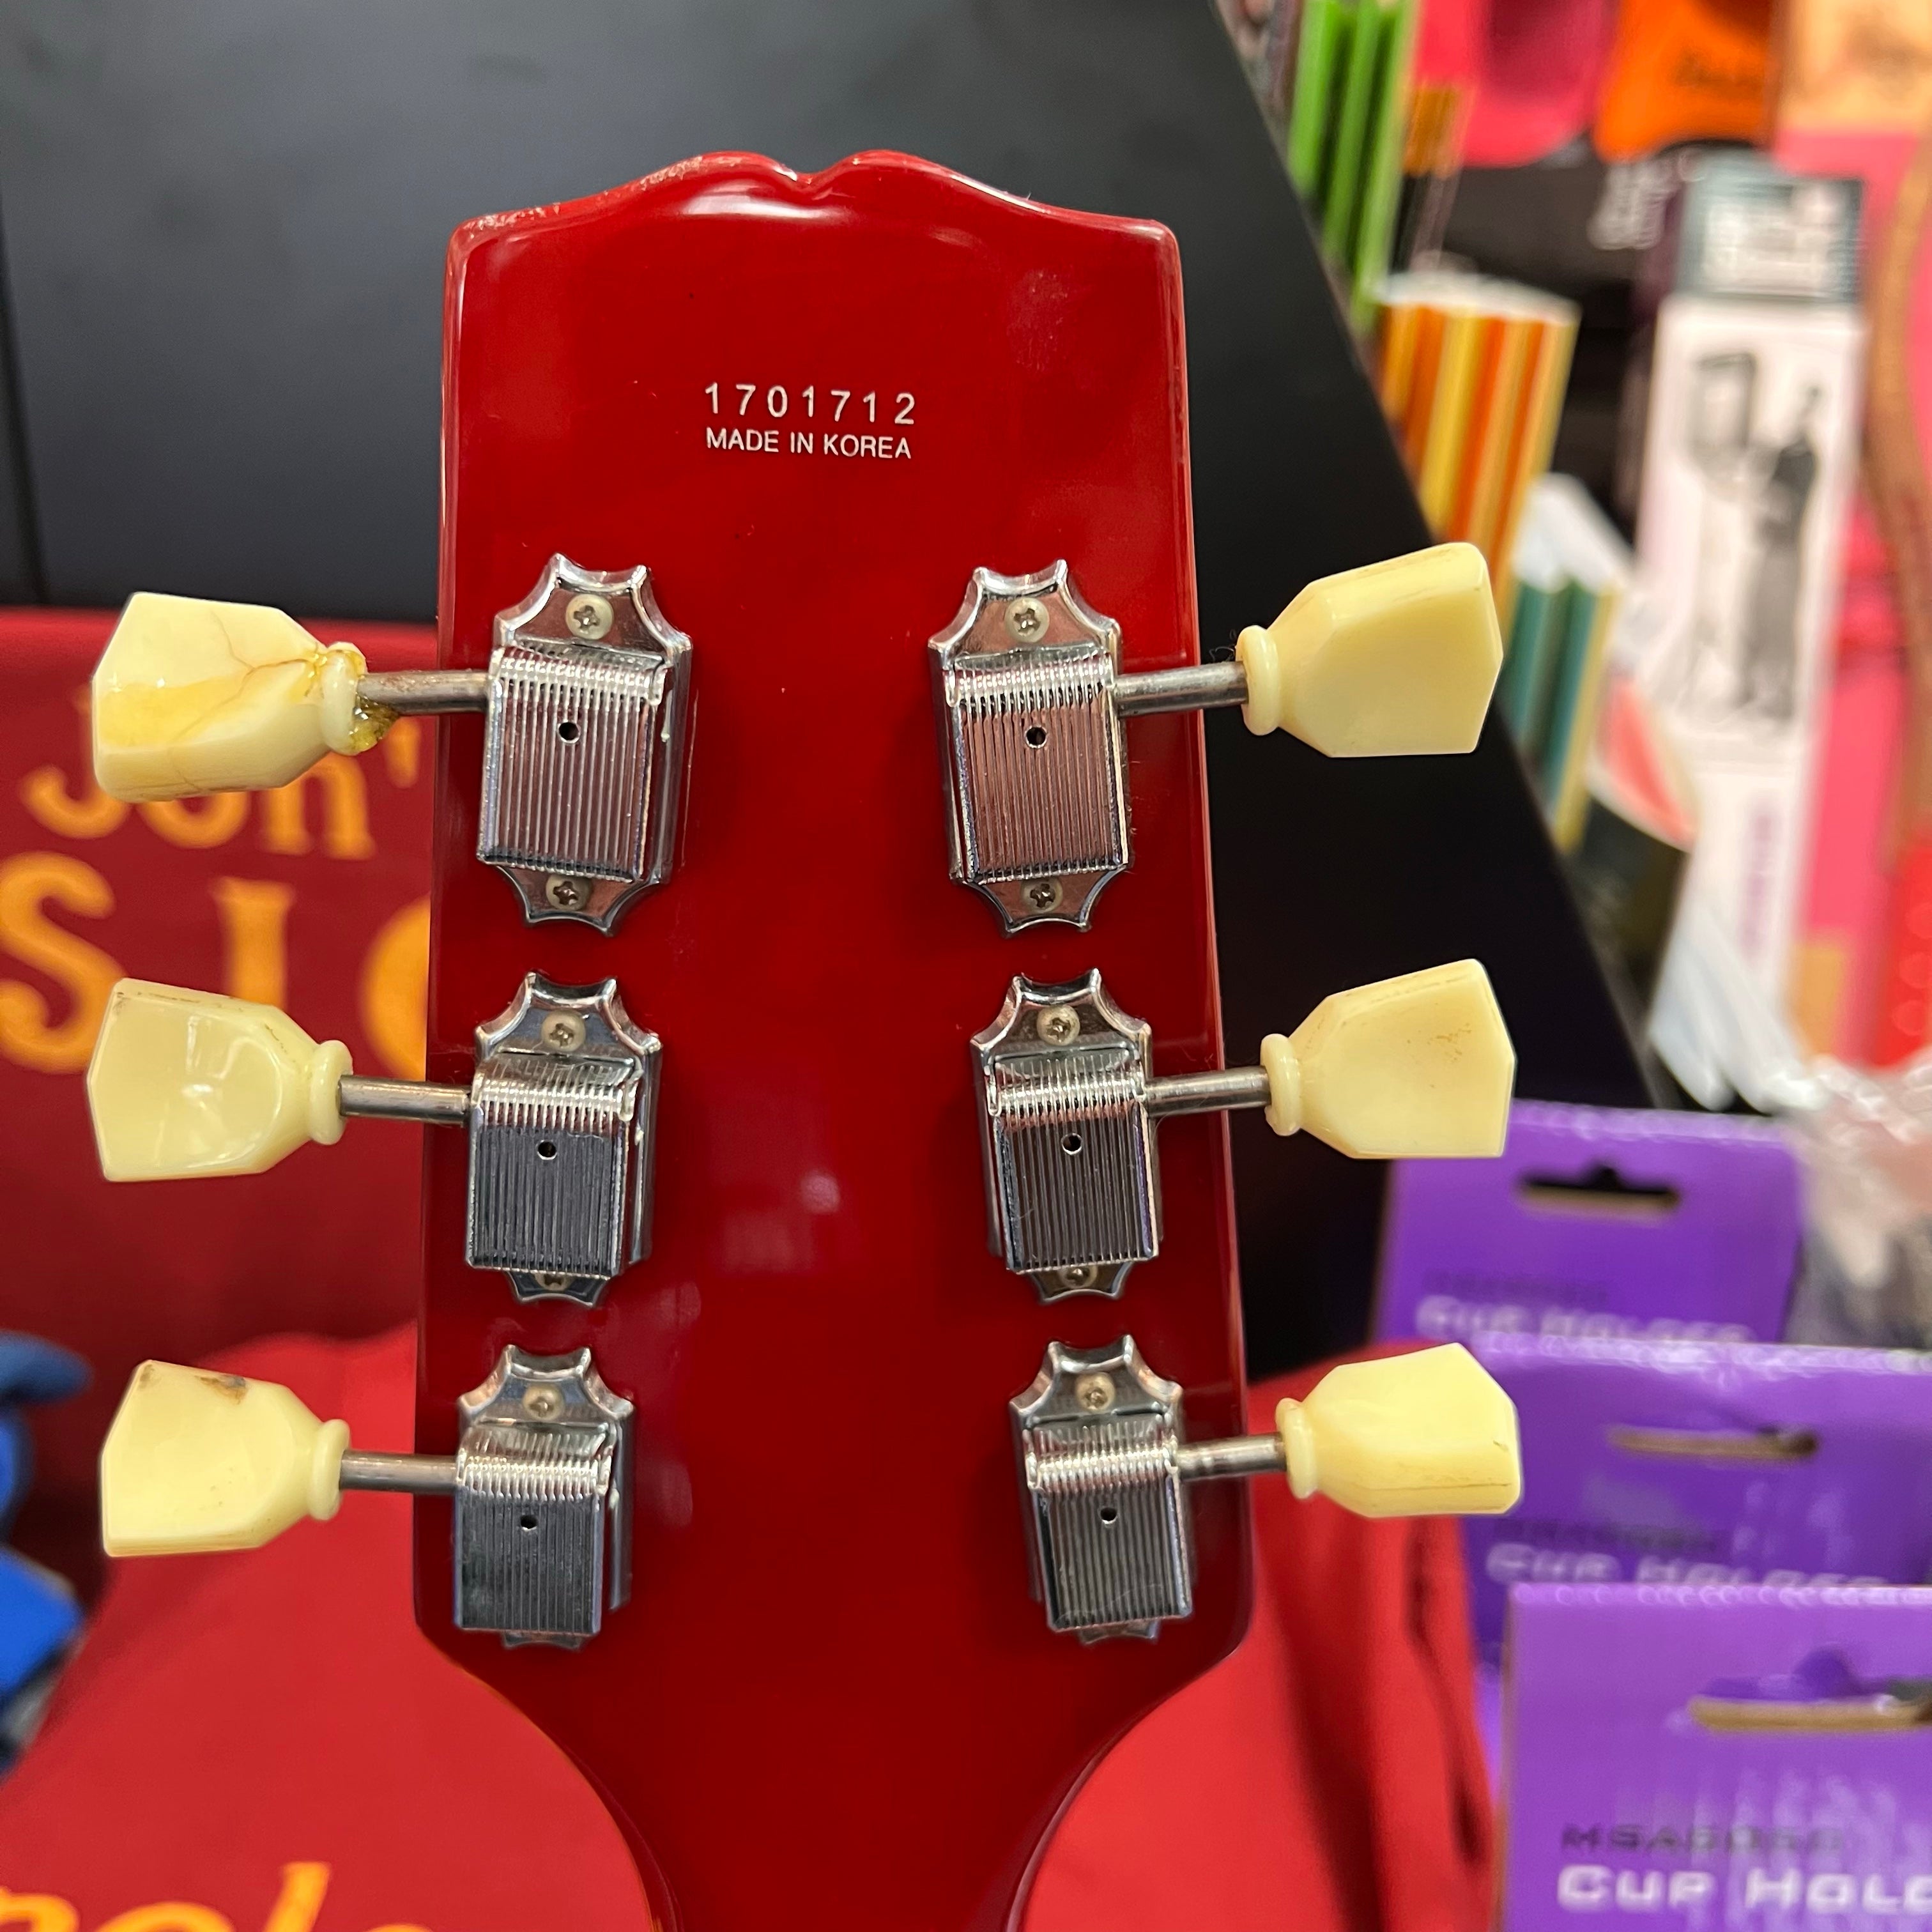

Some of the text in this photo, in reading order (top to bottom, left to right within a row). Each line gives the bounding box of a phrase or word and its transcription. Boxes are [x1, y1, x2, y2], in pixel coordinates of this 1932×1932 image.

[705, 381, 916, 425] 1701712
[706, 427, 912, 459] MADE IN KOREA
[1557, 1863, 1717, 1912] CUP
